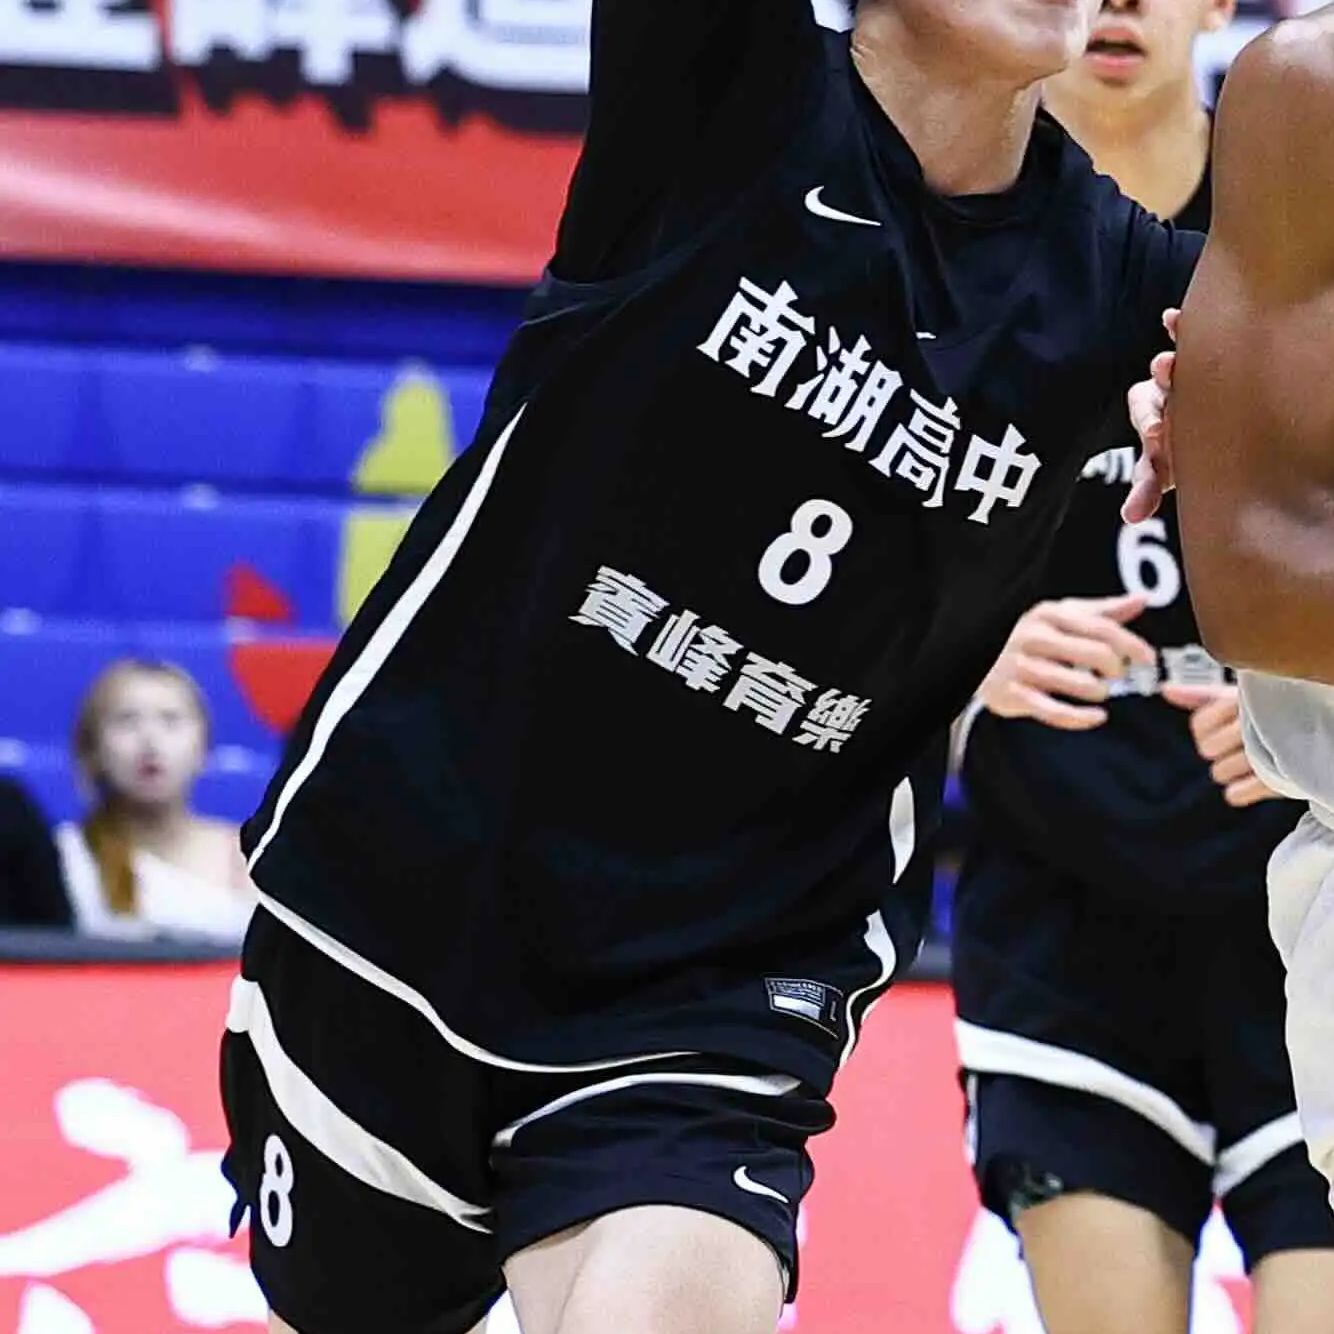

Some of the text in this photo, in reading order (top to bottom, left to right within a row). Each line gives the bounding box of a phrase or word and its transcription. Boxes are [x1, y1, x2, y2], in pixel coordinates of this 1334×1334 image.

[697, 276, 1041, 525] 南湖高中
[757, 499, 854, 606] 8
[1116, 517, 1181, 608] 6
[259, 1134, 295, 1247] 8
